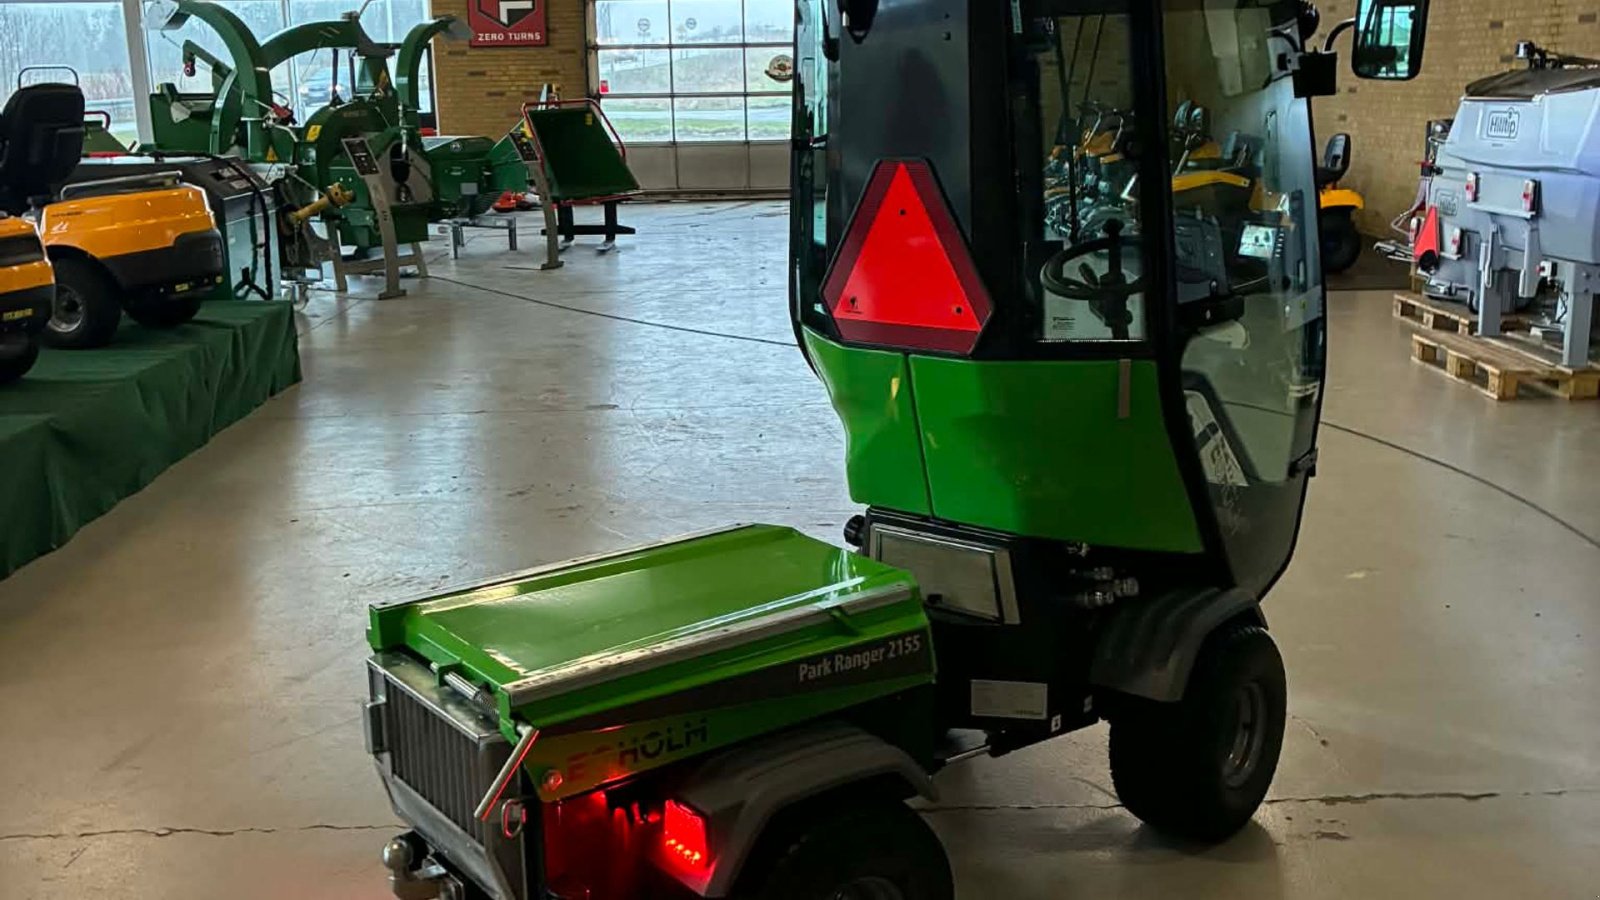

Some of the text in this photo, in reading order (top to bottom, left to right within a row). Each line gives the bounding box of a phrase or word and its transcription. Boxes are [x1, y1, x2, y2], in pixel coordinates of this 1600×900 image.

[478, 32, 541, 41] ZERO TURNS
[1489, 115, 1516, 138] Hilltip
[799, 634, 920, 681] Park Ranger 2155
